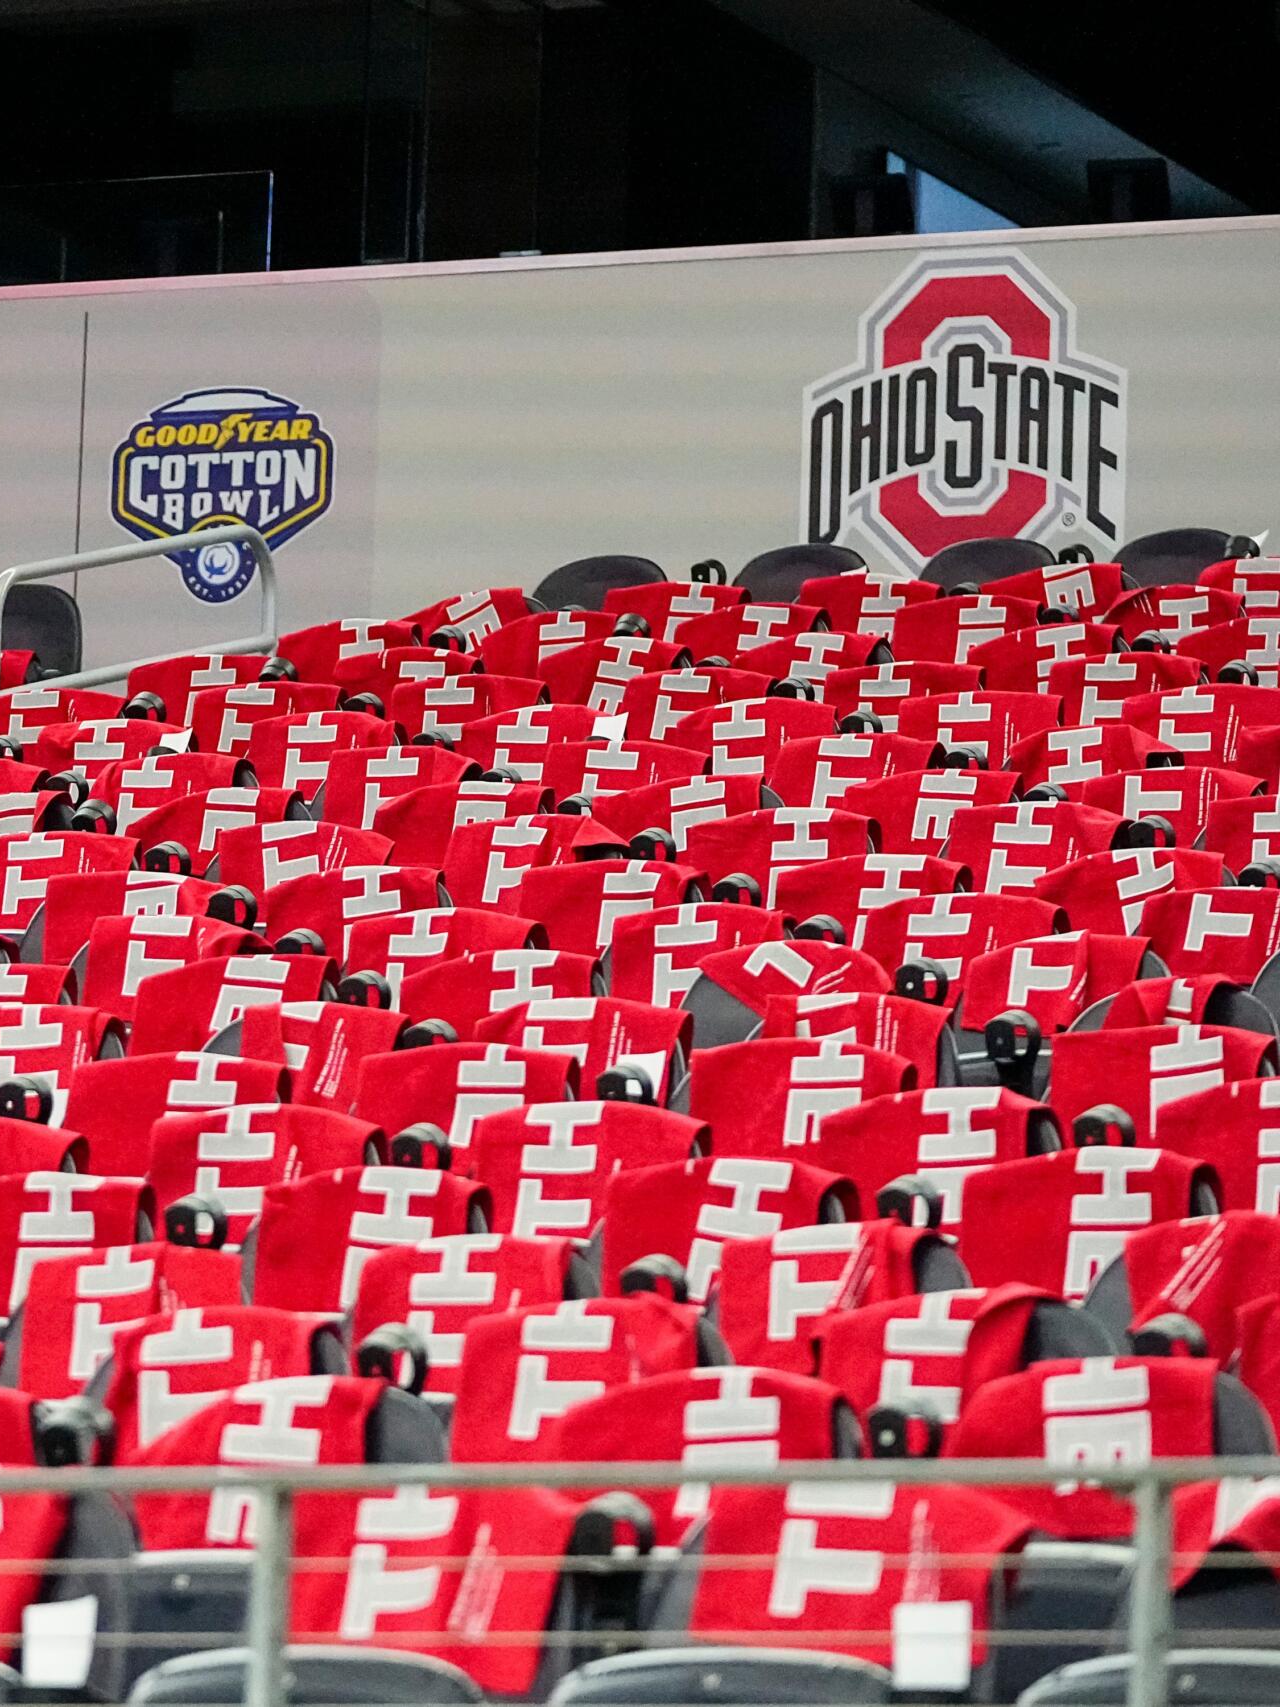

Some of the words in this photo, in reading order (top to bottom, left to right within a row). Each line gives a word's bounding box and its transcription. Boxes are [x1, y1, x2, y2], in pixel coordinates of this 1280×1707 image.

[135, 414, 313, 450] GOODYEAR
[808, 366, 937, 545] OHIO
[944, 343, 1119, 541] STATE
[129, 448, 316, 518] COTTON
[163, 490, 280, 531] BOWL
[984, 799, 1058, 894] TH
[651, 904, 719, 1009] TH
[512, 1100, 605, 1238] TH
[507, 1299, 615, 1441] TH
